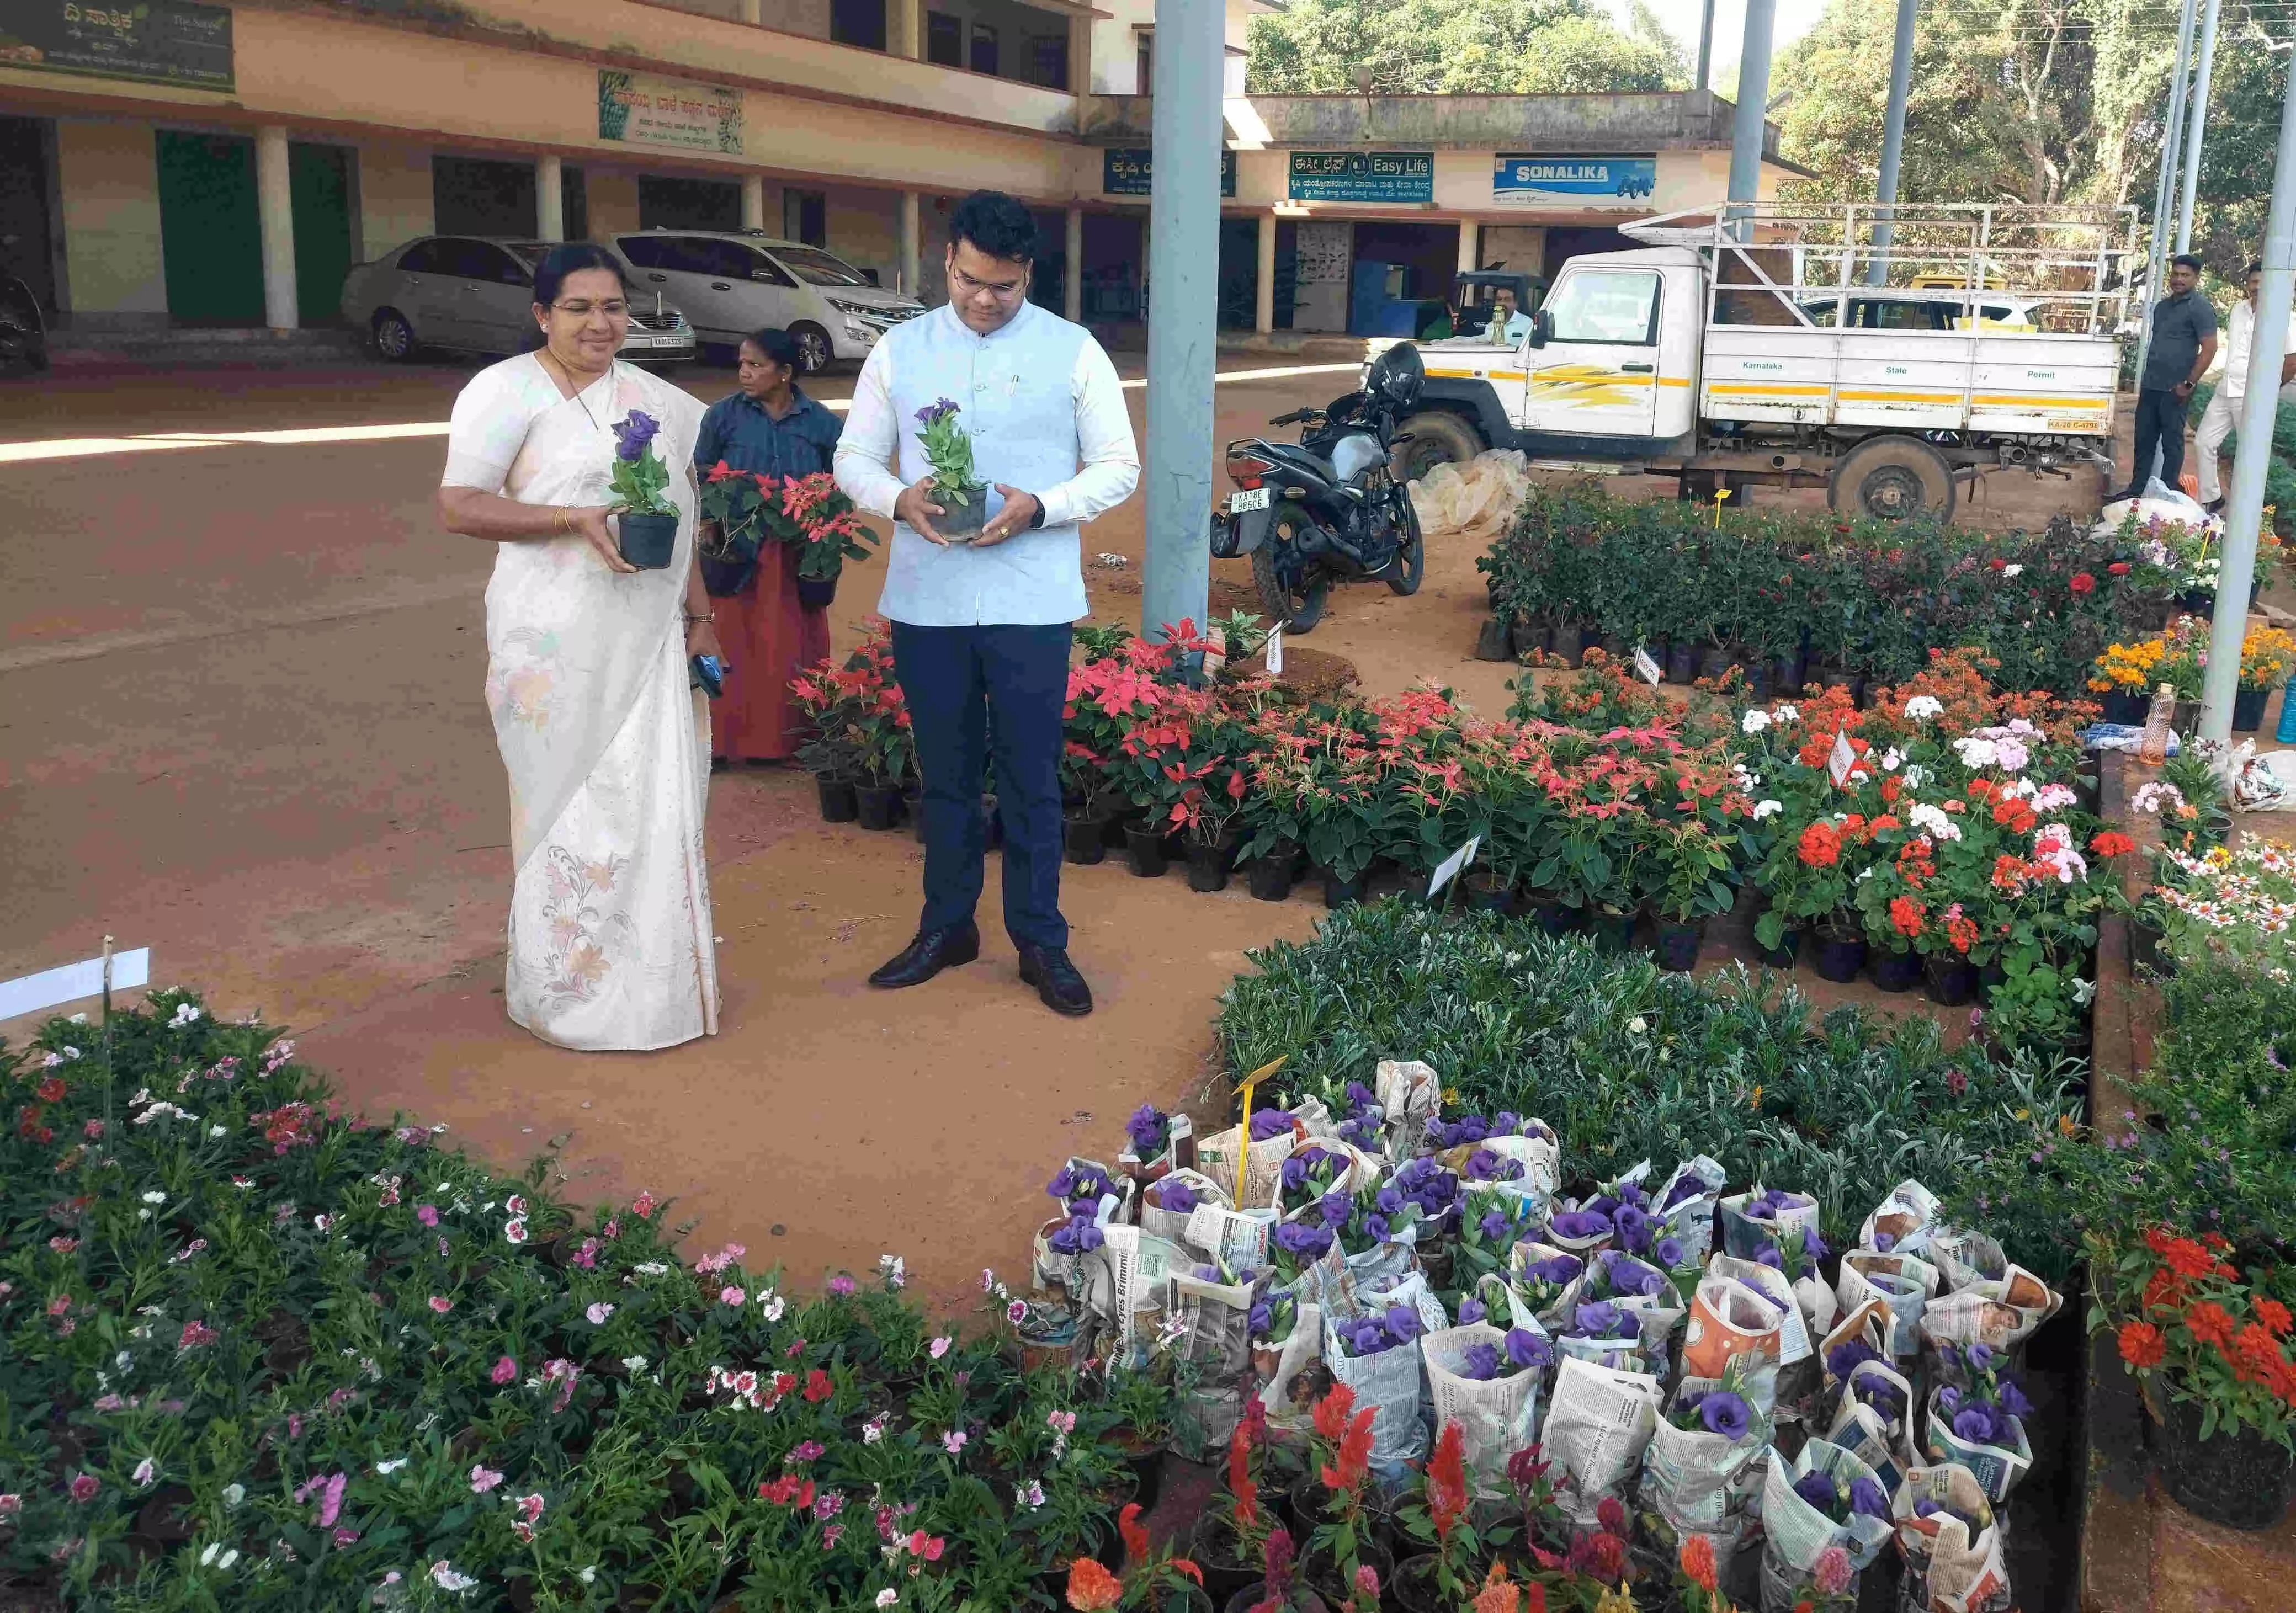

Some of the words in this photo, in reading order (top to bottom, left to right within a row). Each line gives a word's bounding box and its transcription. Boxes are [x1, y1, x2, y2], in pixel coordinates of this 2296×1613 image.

[1374, 159, 1403, 175] Easy
[1406, 159, 1428, 172] Life
[1517, 166, 1609, 182] SONALIKA
[1742, 361, 1783, 370] Karnataka
[1885, 366, 1907, 375] State
[2027, 370, 2055, 379] Permit
[1239, 489, 1263, 502] KA18E
